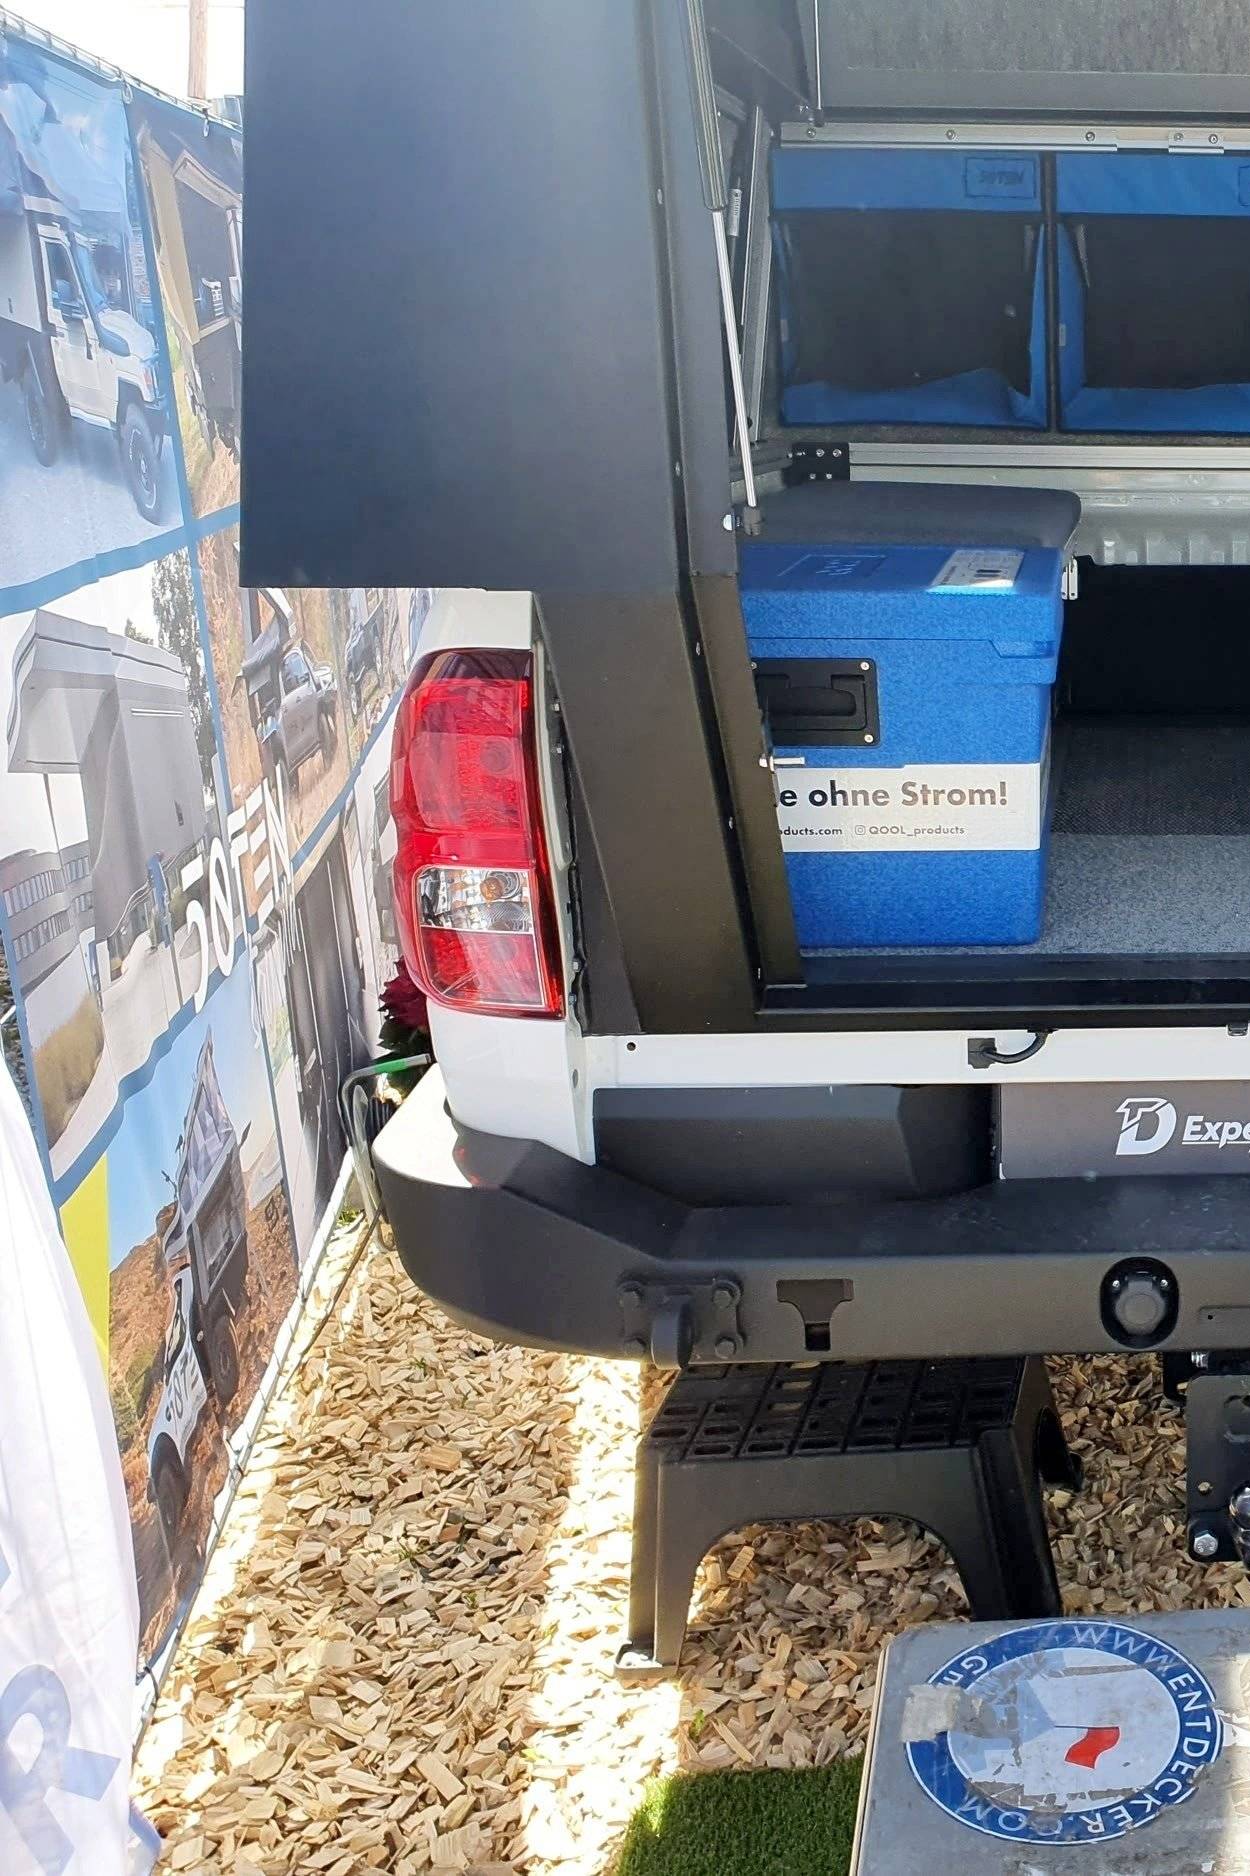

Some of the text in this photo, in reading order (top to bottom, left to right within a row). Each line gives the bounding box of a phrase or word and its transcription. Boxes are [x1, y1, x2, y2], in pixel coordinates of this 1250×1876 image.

[808, 780, 891, 807] ohne
[901, 781, 1007, 806] Strom!
[869, 825, 965, 837] QOOL_products
